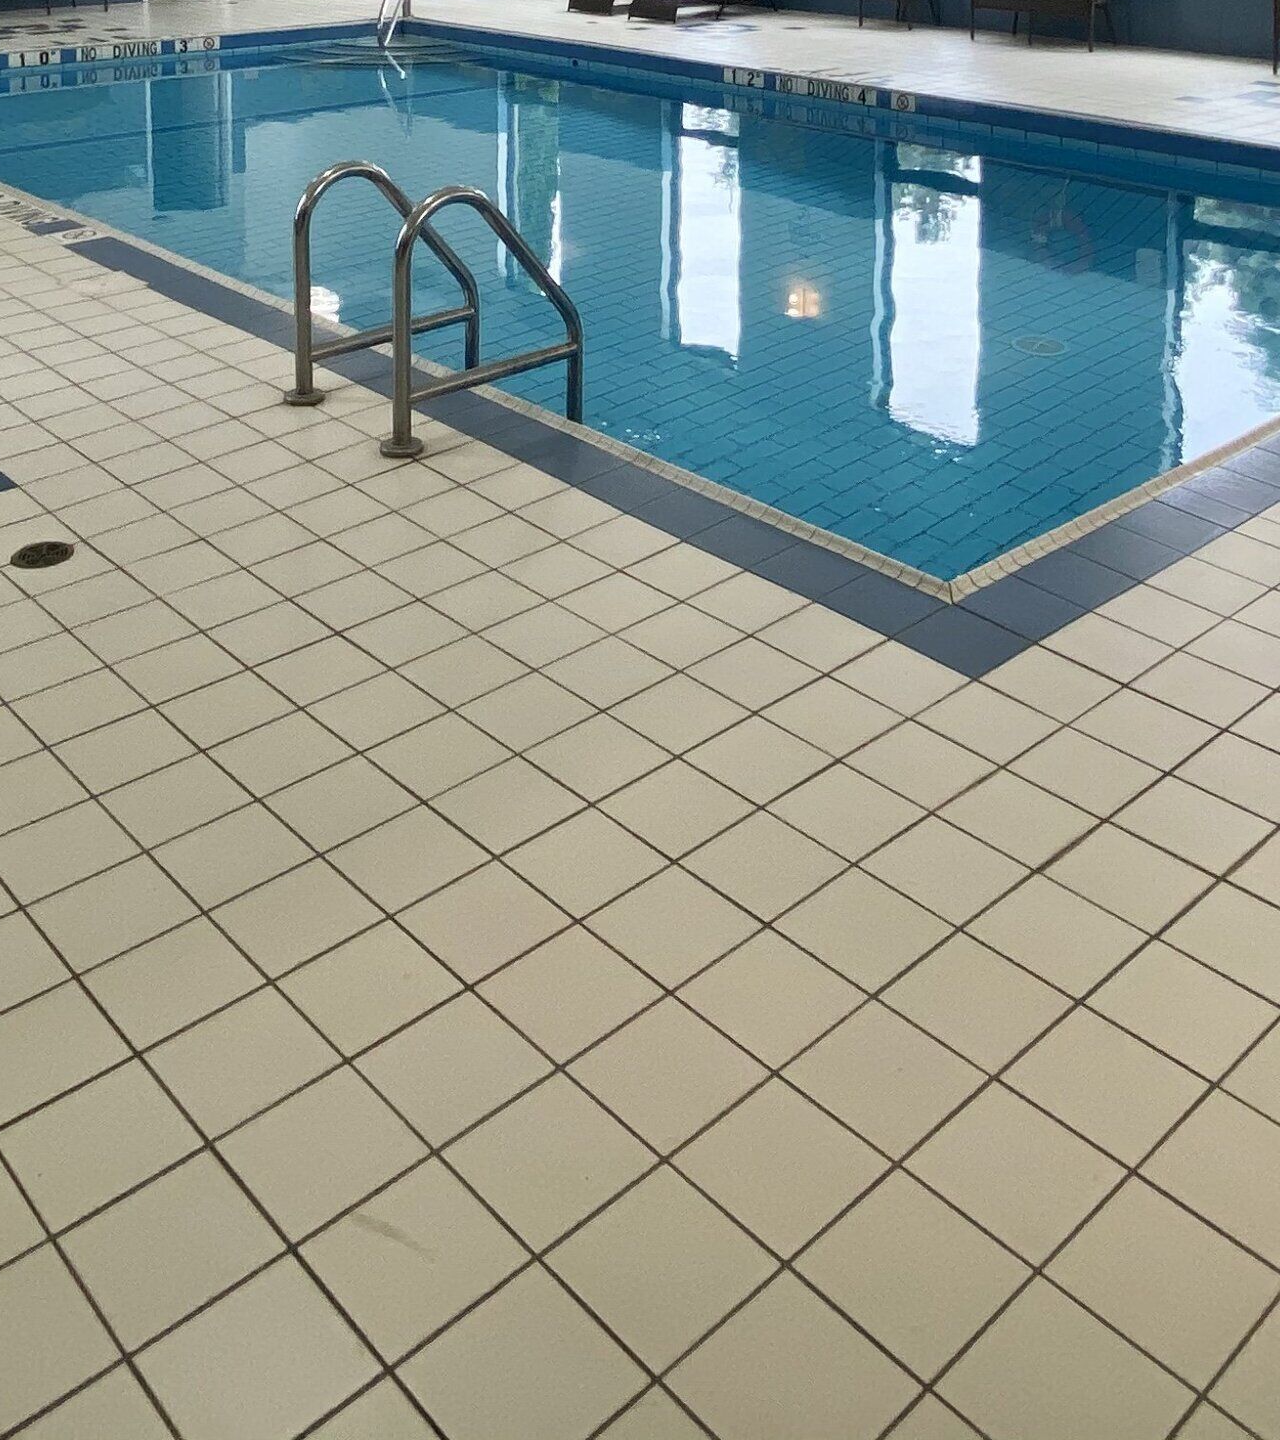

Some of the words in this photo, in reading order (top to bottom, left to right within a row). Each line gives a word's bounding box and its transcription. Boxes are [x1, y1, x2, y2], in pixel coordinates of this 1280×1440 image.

[81, 47, 97, 62] NO
[113, 41, 158, 59] DIVING
[778, 75, 793, 92] NO
[807, 80, 849, 101] DIVING
